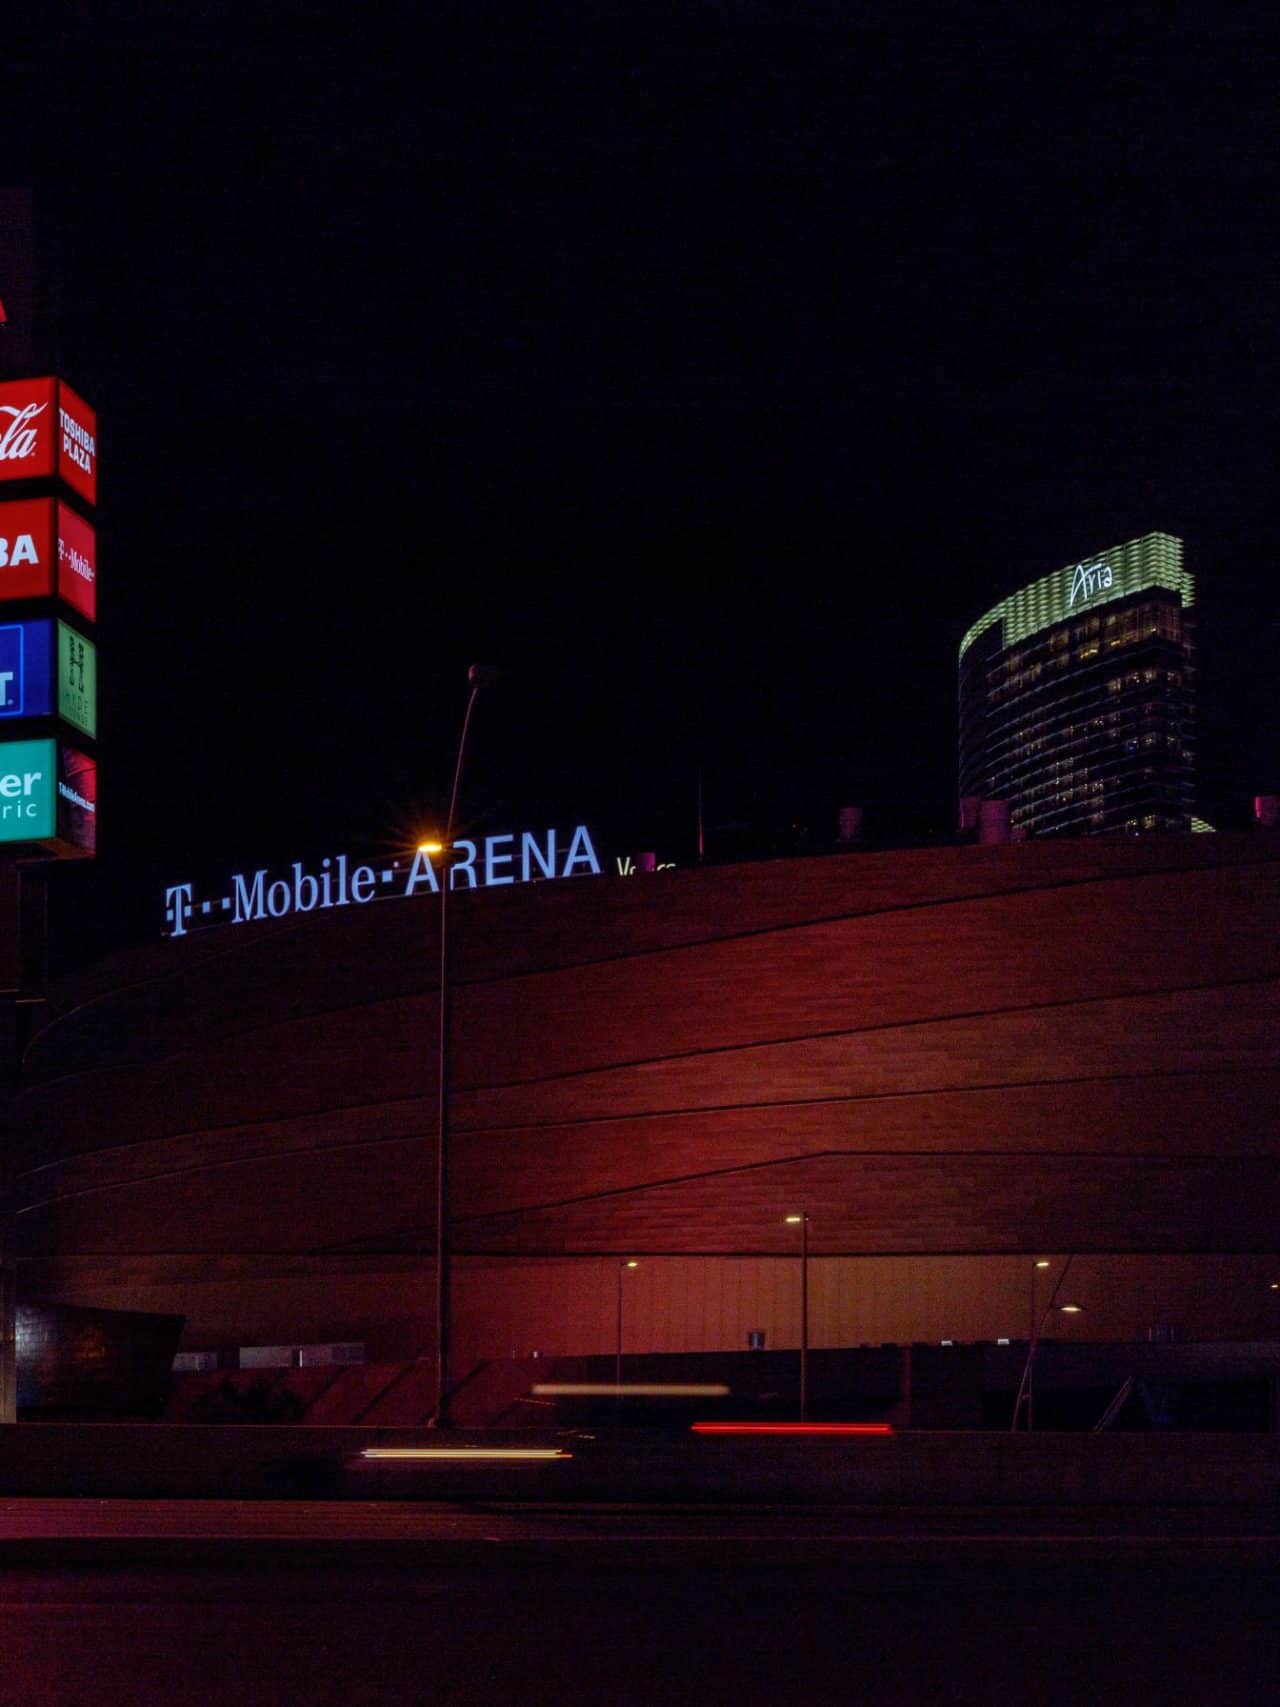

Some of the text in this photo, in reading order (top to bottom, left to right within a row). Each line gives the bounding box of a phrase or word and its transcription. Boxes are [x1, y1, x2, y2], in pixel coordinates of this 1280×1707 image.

[59, 407, 96, 457] TOSHIBA
[63, 432, 92, 475] PLAZA
[1069, 562, 1114, 607] Aria
[405, 825, 602, 896] ARENA
